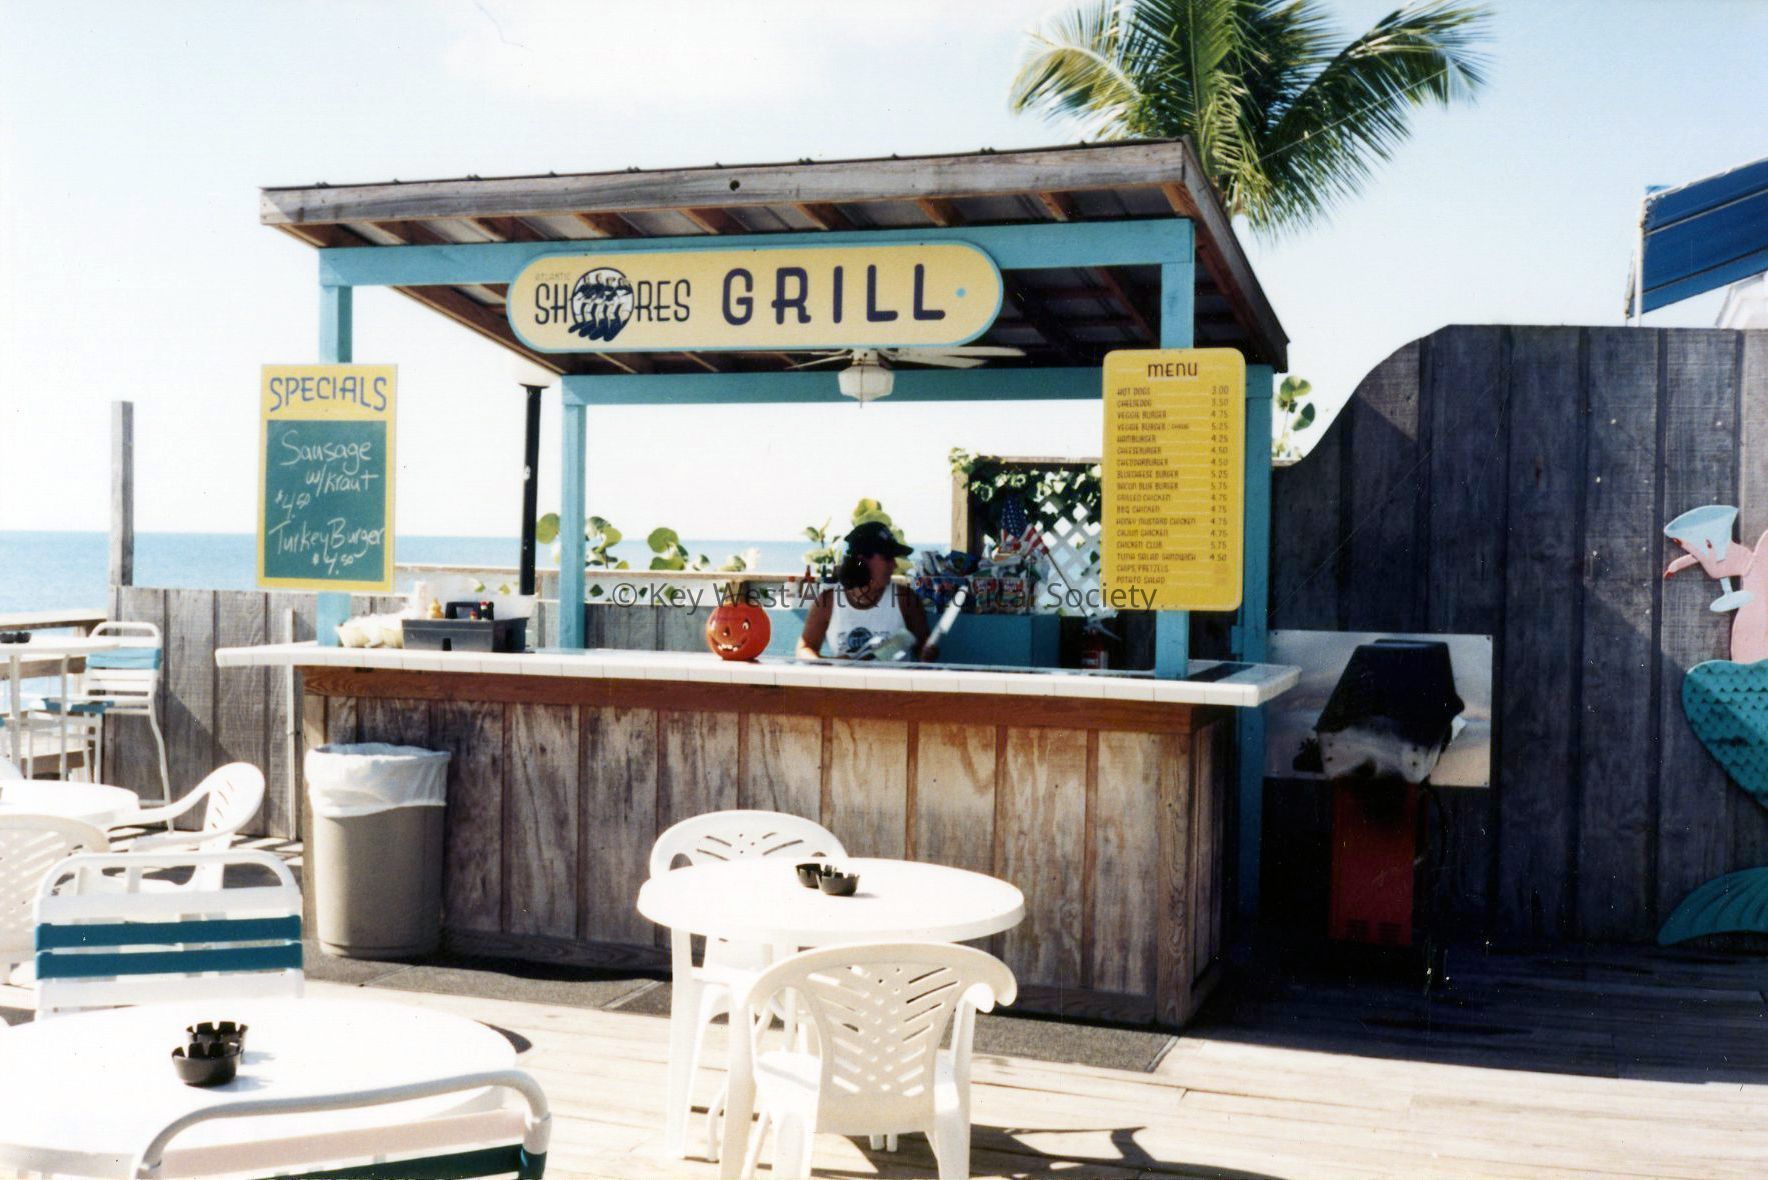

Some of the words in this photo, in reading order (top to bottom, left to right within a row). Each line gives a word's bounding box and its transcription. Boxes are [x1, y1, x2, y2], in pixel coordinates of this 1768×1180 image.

[721, 264, 946, 326] GRILL
[269, 376, 388, 412] SPECIALS
[1117, 411, 1140, 420] VEGGIE
[1142, 411, 1167, 419] BURGER
[1142, 422, 1166, 431] BURGER
[1117, 435, 1157, 443] HAMBURGER
[280, 429, 372, 476] Sausage
[1155, 470, 1179, 479] BURGER
[1155, 482, 1179, 491] BURGER
[1143, 494, 1171, 502] CHICKEN
[1132, 506, 1161, 514] CHICKEN
[1170, 518, 1196, 526] CHICKEN
[1140, 529, 1168, 538] CHICKEN
[268, 519, 329, 560] Turkey
[327, 517, 385, 557] Burger
[1117, 541, 1143, 550] CHICKEN
